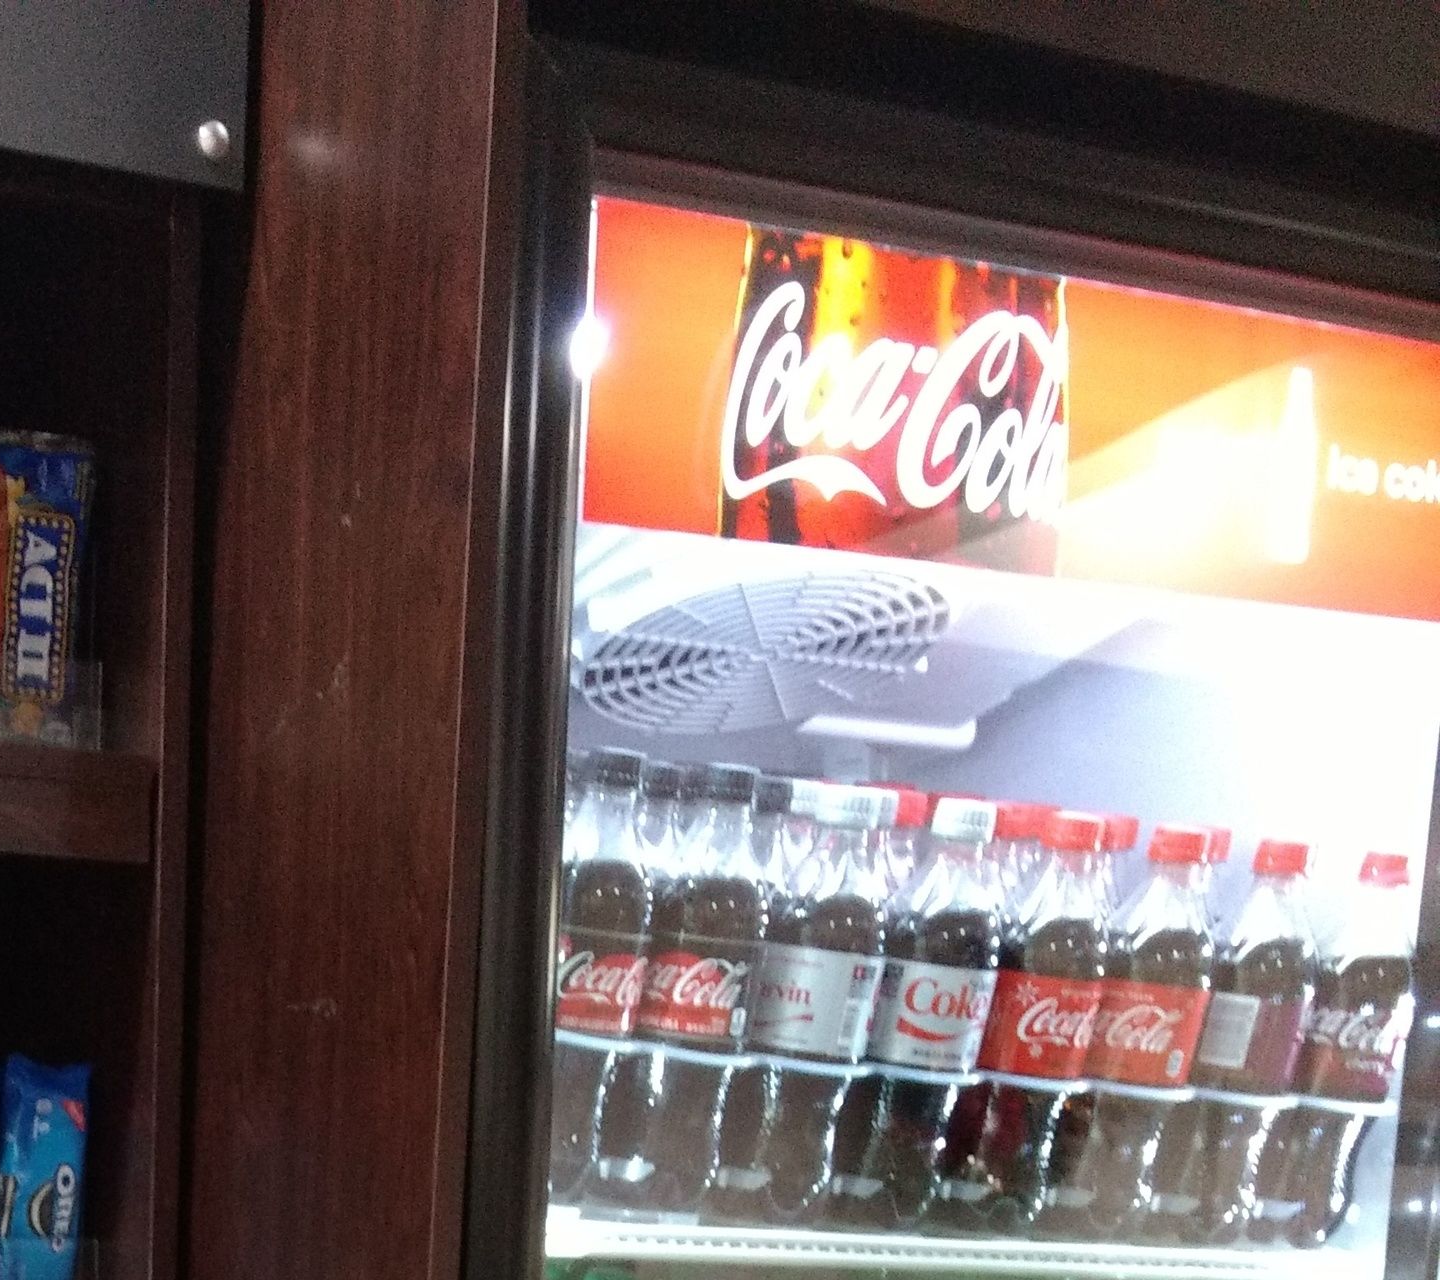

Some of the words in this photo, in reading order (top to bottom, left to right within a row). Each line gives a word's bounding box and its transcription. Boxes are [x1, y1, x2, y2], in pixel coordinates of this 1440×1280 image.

[725, 281, 1069, 527] Coca-Cola
[1384, 459, 1440, 504] col
[18, 530, 59, 624] ACT
